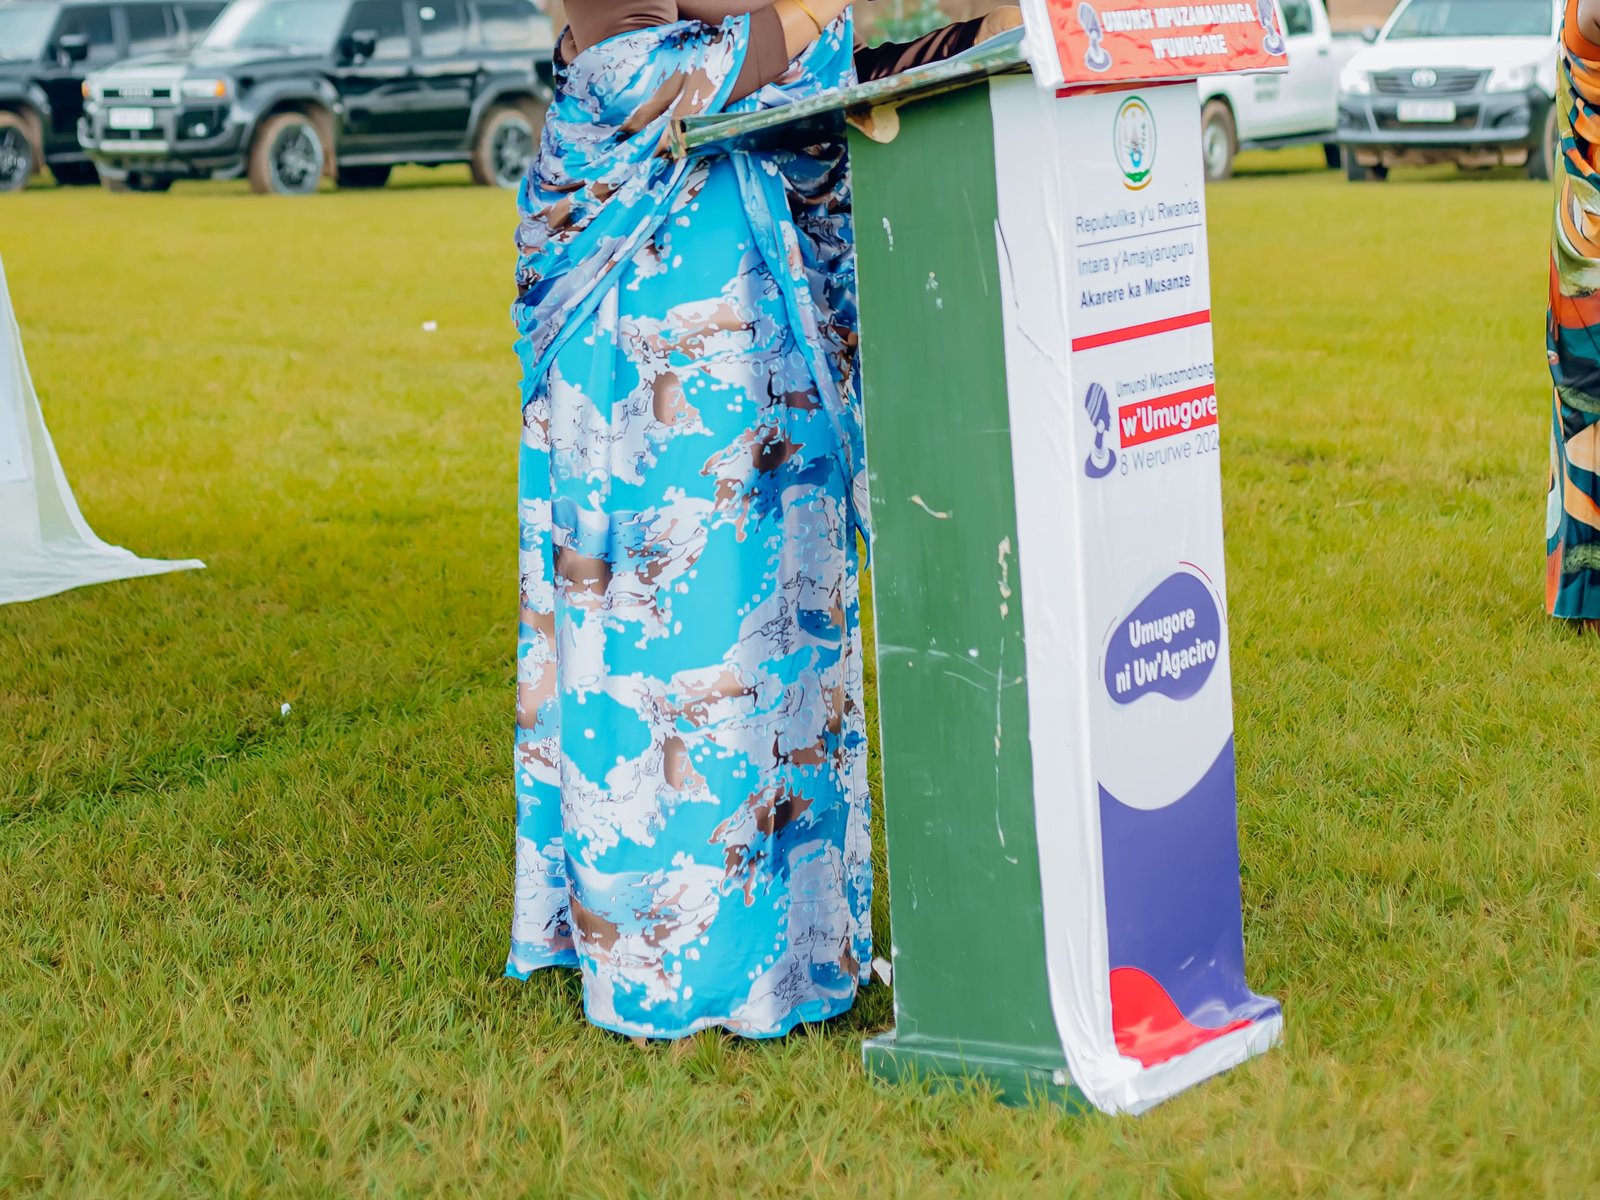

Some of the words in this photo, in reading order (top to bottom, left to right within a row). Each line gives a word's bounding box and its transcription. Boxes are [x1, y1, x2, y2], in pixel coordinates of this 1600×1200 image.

[1075, 209, 1136, 235] Repubulika
[1158, 198, 1200, 220] Rwanda
[1077, 257, 1110, 276] Intara
[1080, 287, 1125, 308] Akarere
[1128, 282, 1141, 299] ka
[1144, 274, 1191, 295] Musanze
[1115, 374, 1148, 397] Umunsi
[1121, 394, 1217, 438] w'Umugore
[1120, 454, 1129, 476] 8
[1132, 440, 1192, 472] Werurwe
[1195, 429, 1220, 455] 202
[1128, 607, 1196, 648] Umugore
[1115, 663, 1132, 694] ni
[1133, 637, 1216, 687] Uw'Agaciro
